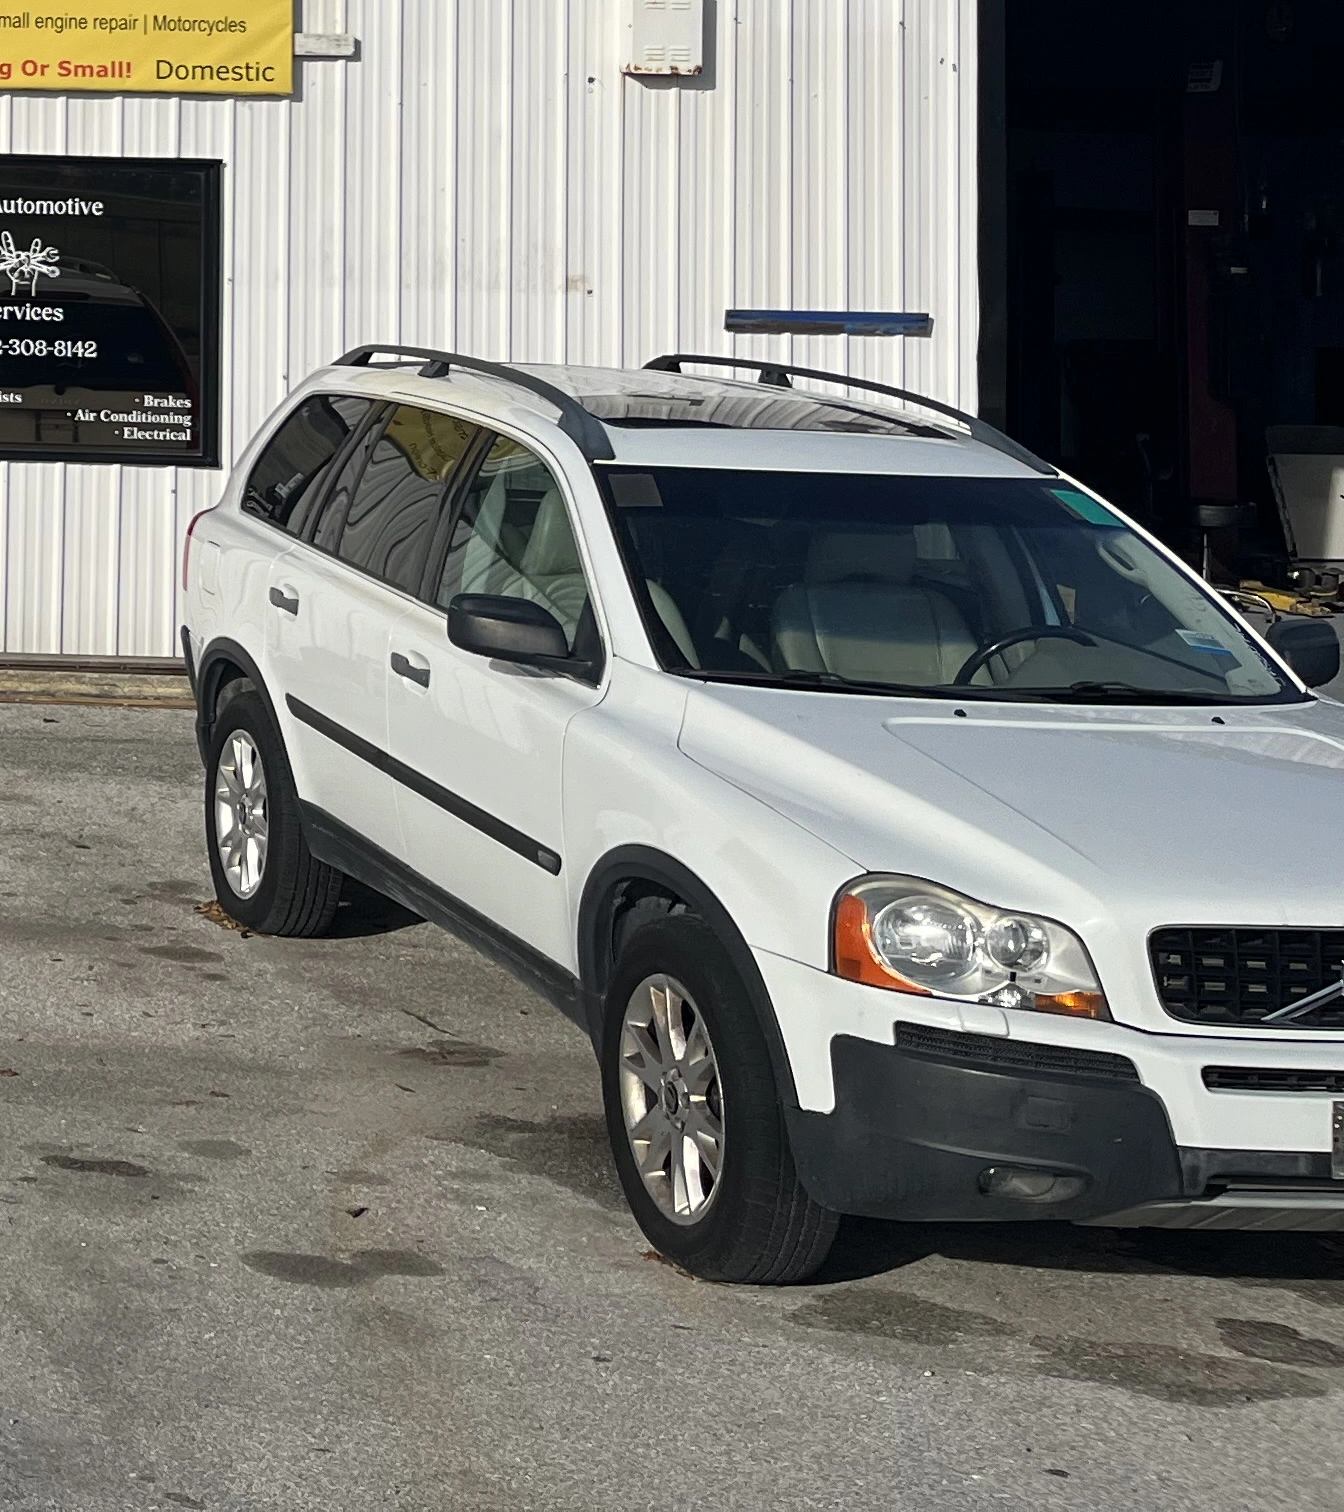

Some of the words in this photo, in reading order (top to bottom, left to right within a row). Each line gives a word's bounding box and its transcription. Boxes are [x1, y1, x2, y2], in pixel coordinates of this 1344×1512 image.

[35, 13, 88, 34] engine
[93, 14, 139, 34] repair
[154, 15, 246, 36] Motorcycles
[22, 60, 49, 76] Or
[58, 61, 130, 78] Small!
[157, 60, 274, 81] Domestic
[144, 395, 191, 408] Brakes
[75, 409, 97, 421] Air
[100, 410, 191, 426] Conditioning
[123, 426, 191, 440] Electrical
